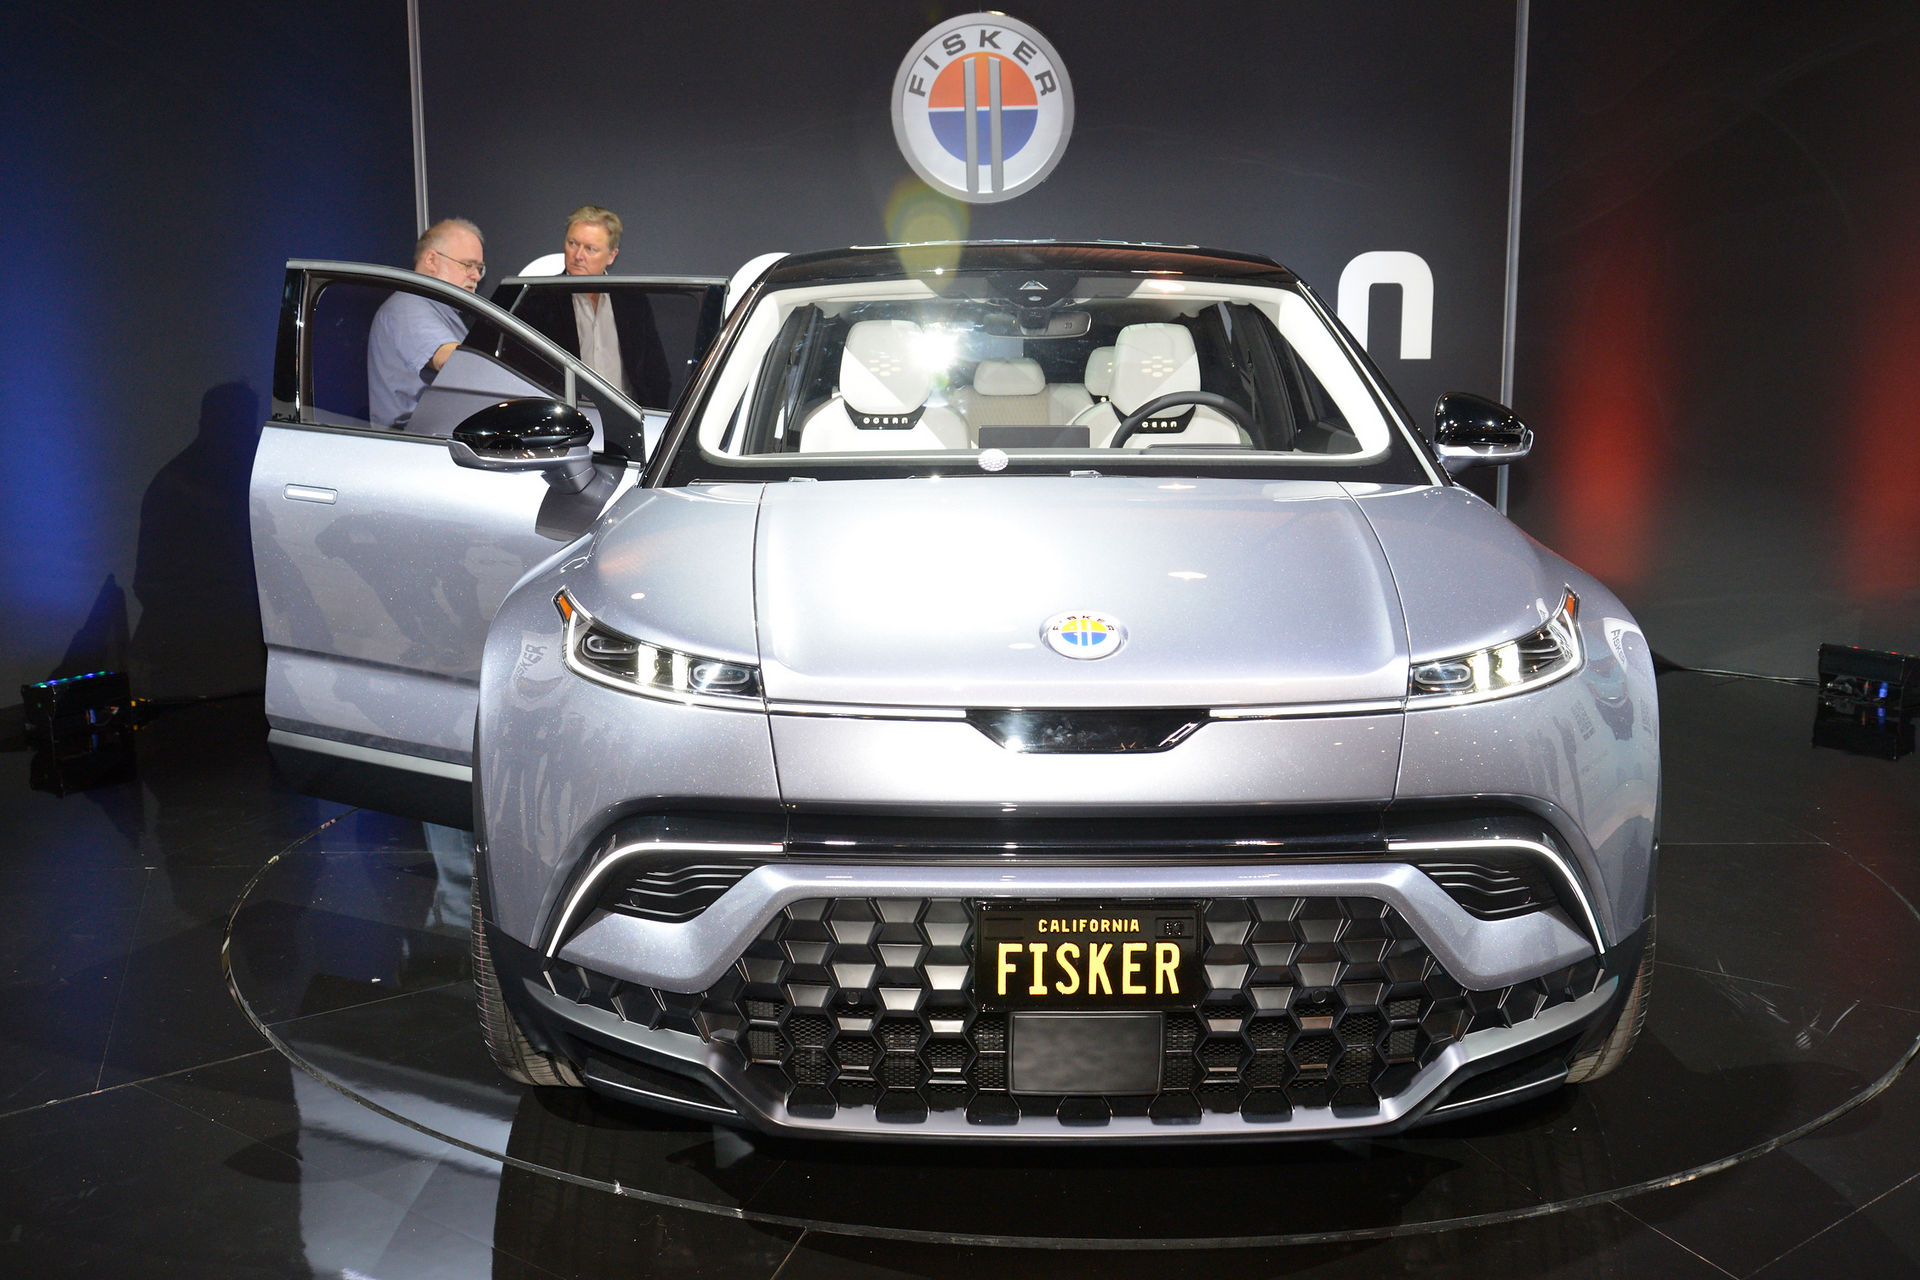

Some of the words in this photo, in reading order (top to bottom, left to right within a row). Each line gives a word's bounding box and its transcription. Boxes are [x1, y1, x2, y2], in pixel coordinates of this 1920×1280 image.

[908, 29, 1057, 97] FISKER
[1038, 918, 1140, 933] CALIFORNIA
[997, 942, 1181, 996] FISKER
